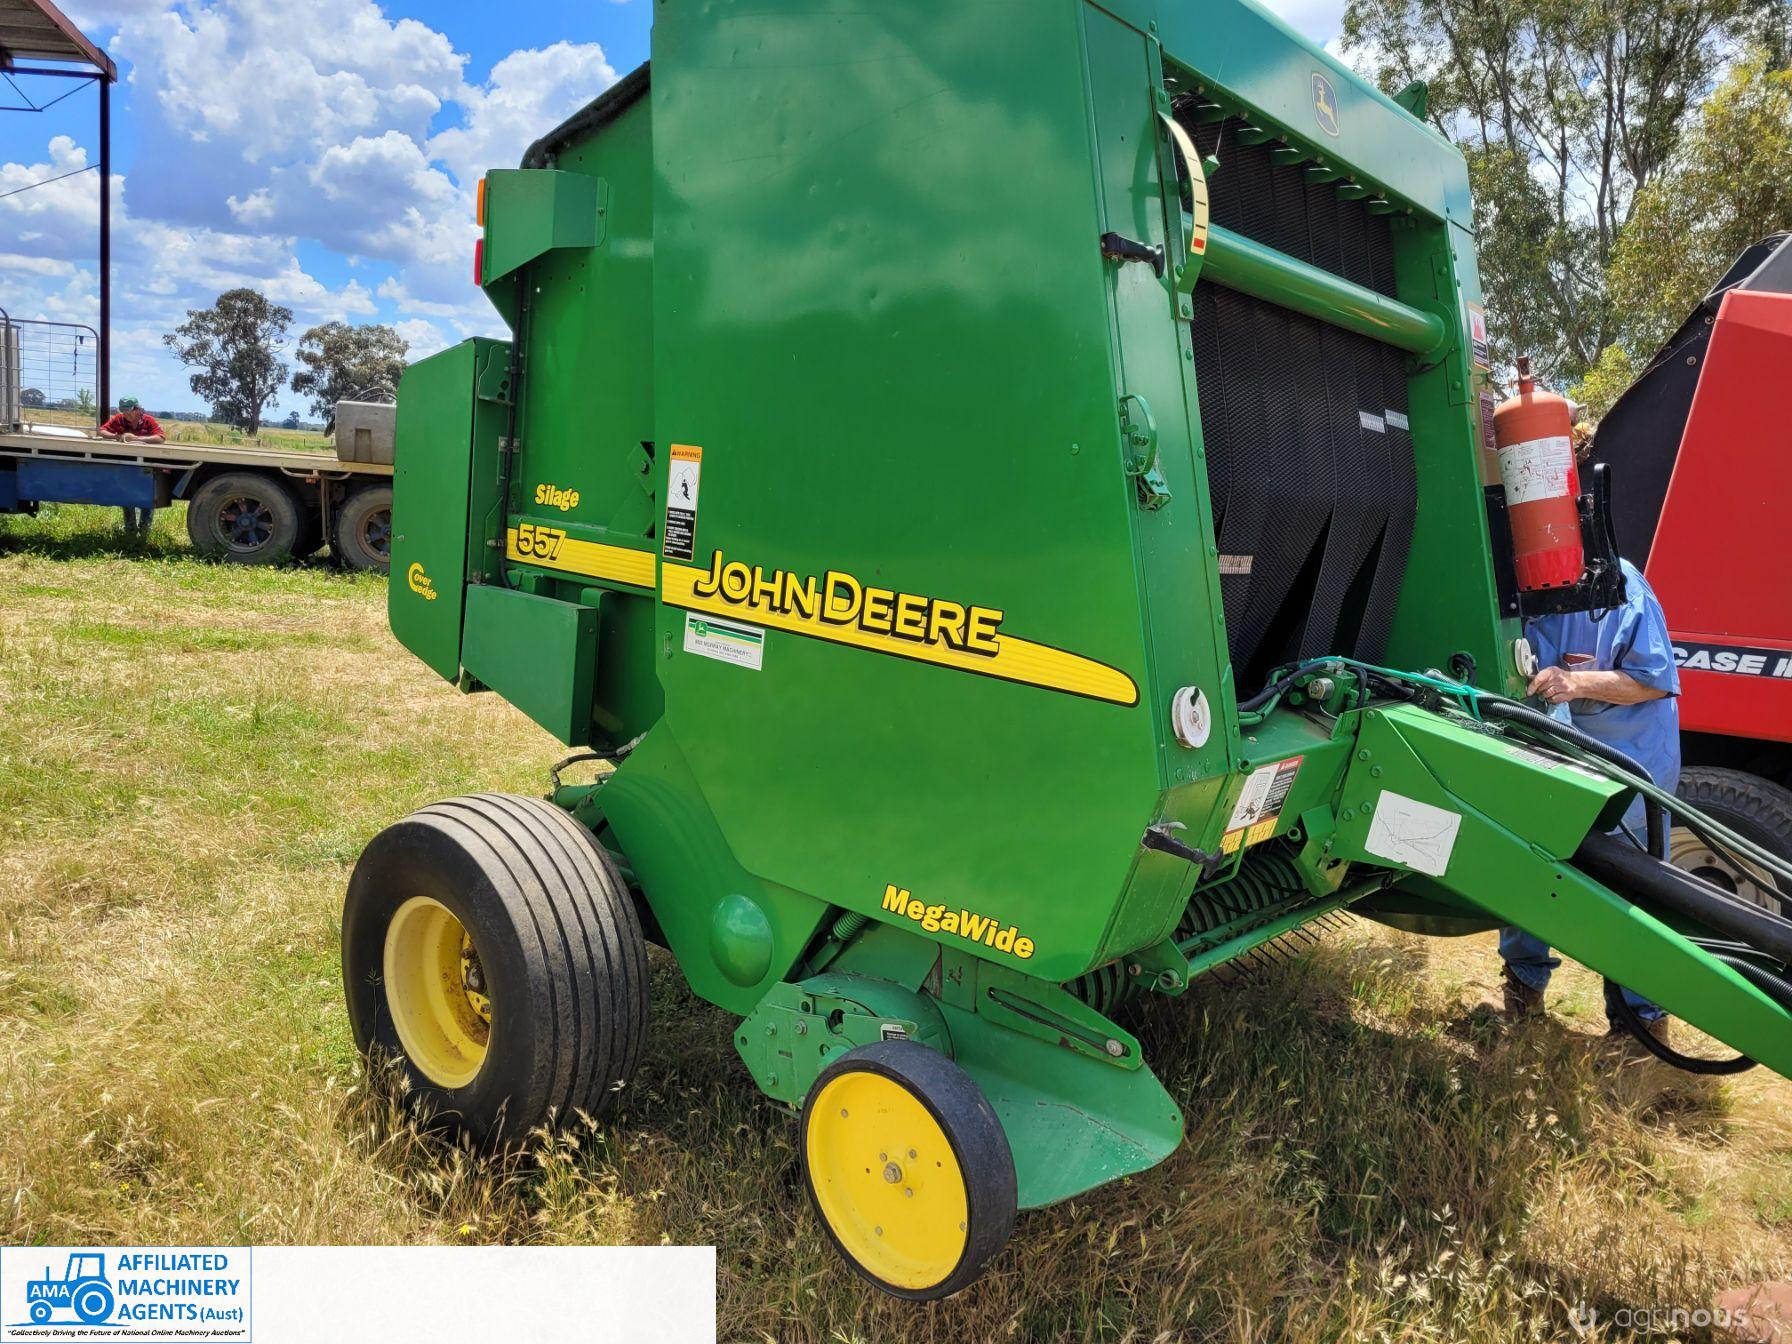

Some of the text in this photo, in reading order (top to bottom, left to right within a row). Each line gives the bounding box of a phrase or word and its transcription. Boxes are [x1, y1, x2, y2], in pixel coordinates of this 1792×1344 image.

[535, 484, 580, 512] Silage
[518, 523, 567, 561] 557
[694, 549, 1004, 658] JOHN DEERE
[1672, 646, 1767, 675] CASE
[881, 883, 1035, 960] MegaWide
